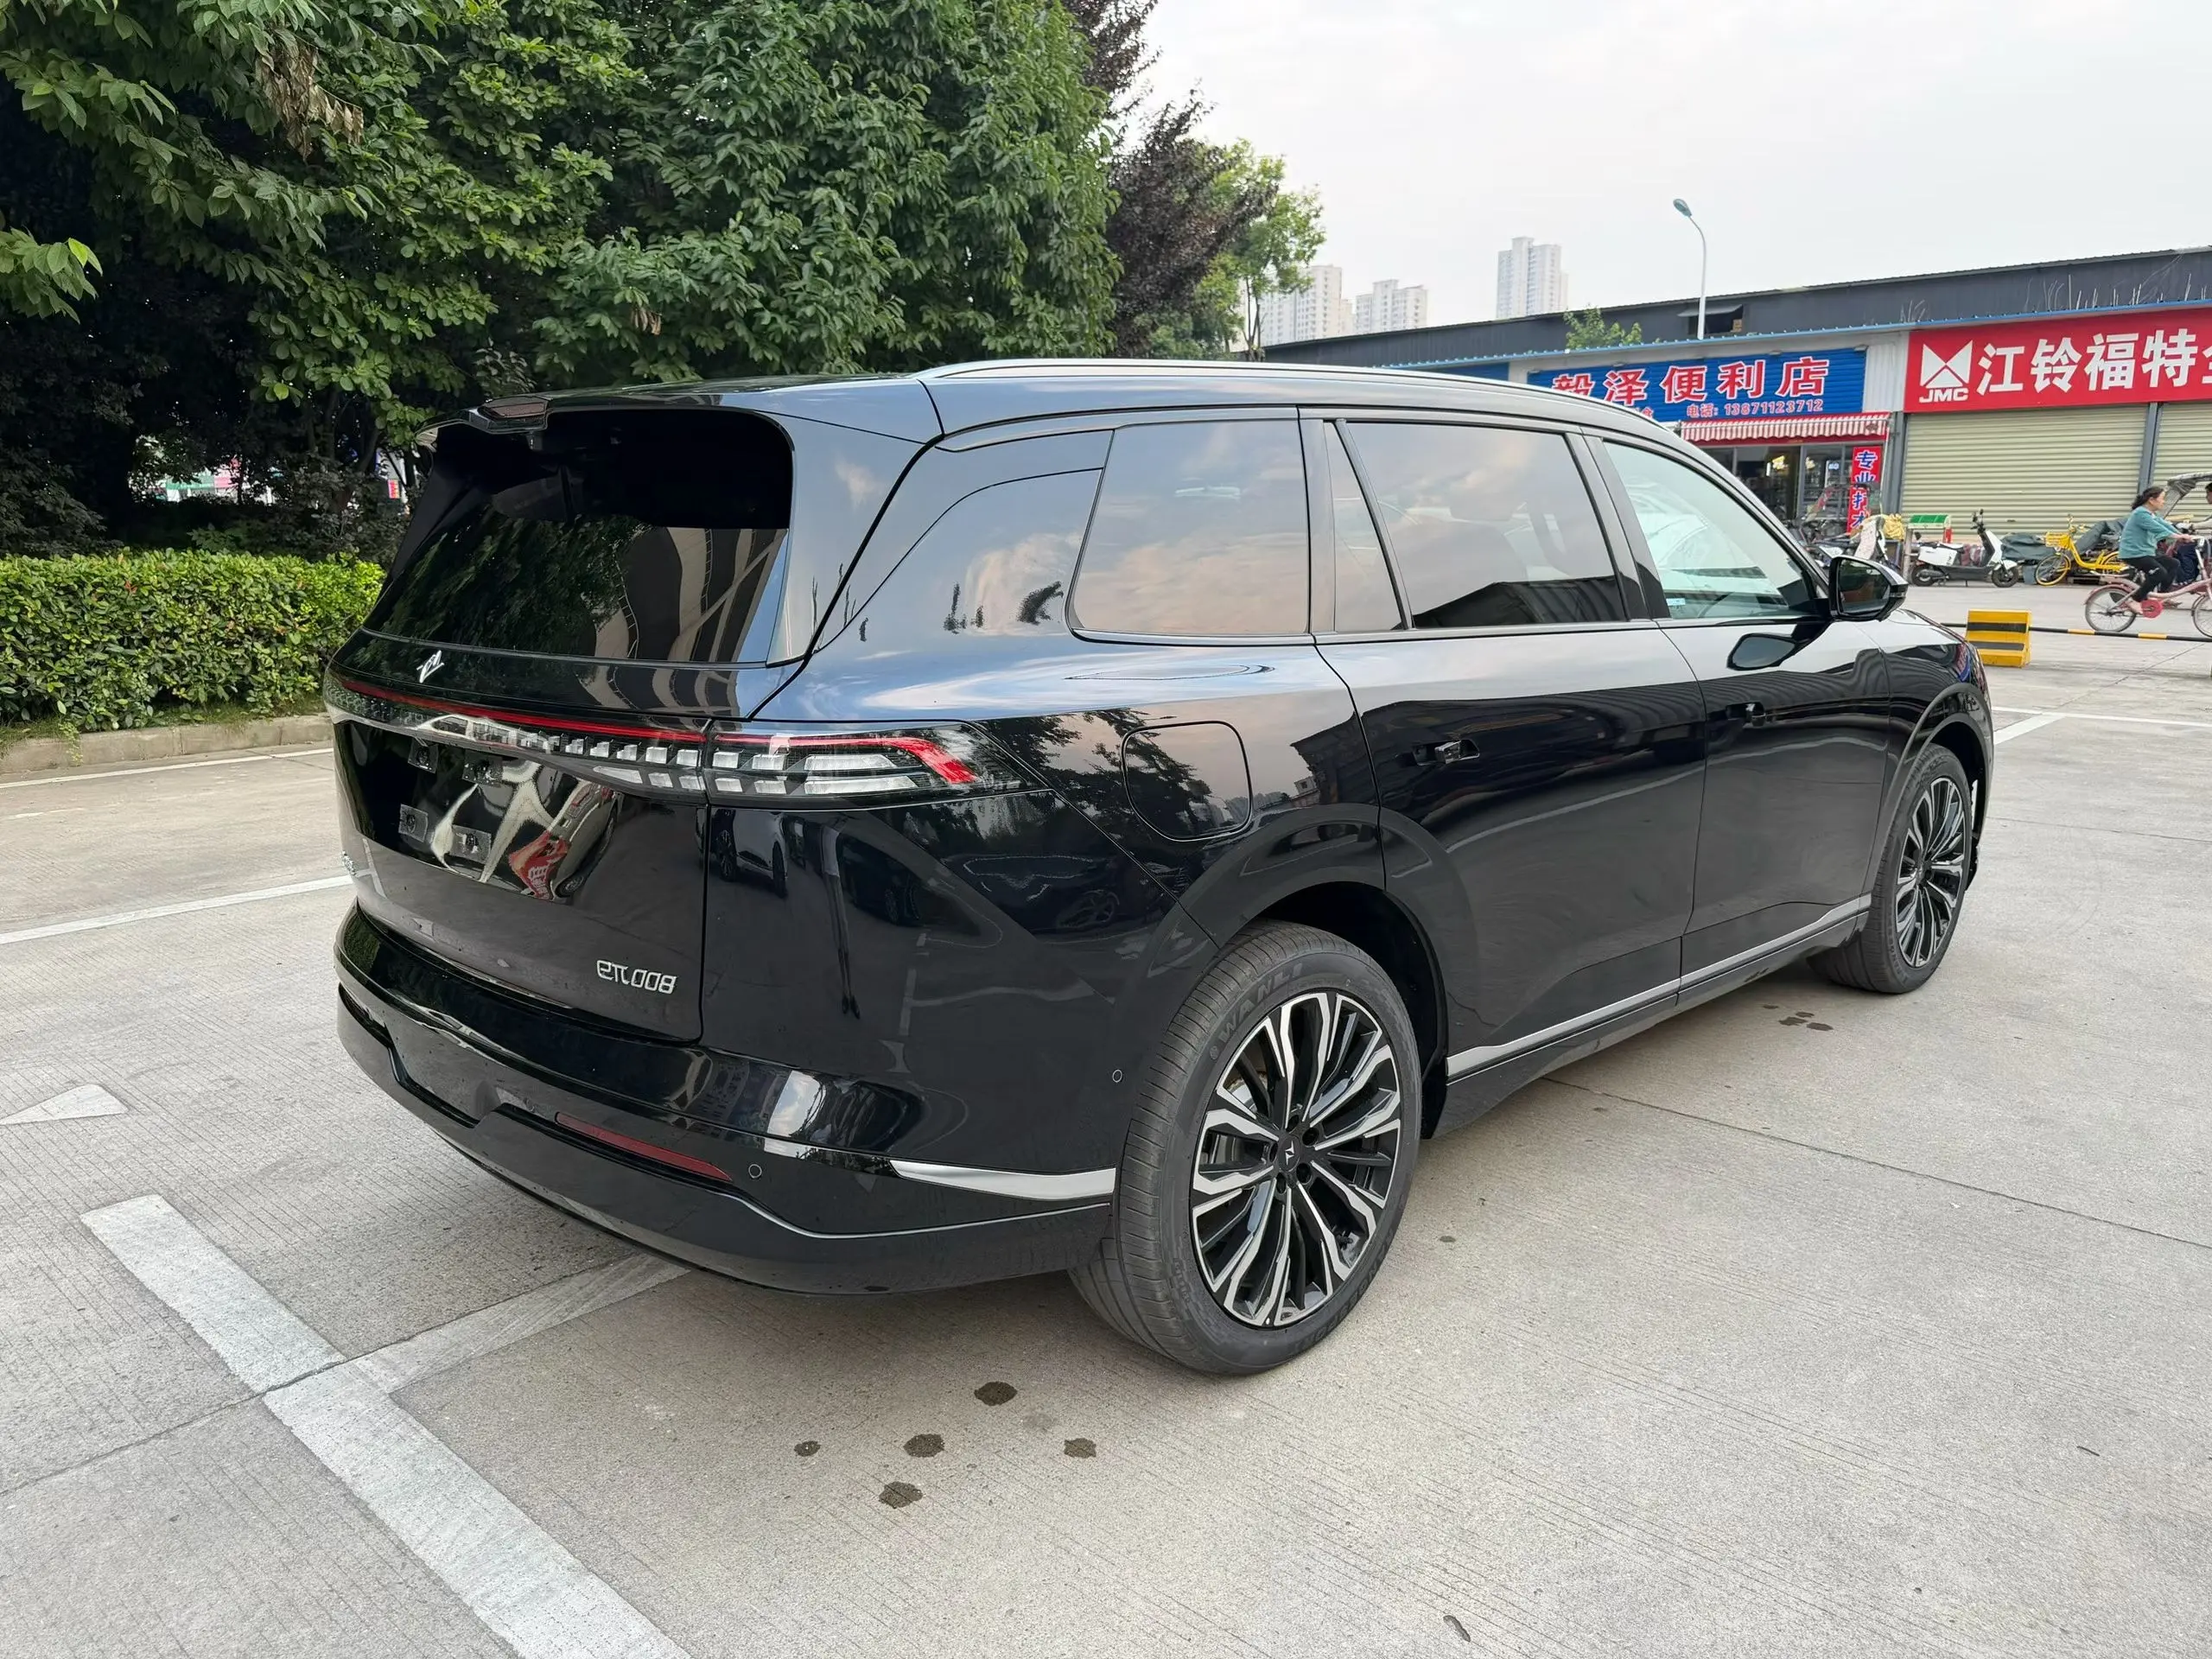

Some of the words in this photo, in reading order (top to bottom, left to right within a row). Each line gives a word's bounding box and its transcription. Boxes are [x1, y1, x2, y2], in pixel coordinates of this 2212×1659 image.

[1977, 328, 2212, 396] 江铃福特
[1918, 387, 1969, 404] JMC
